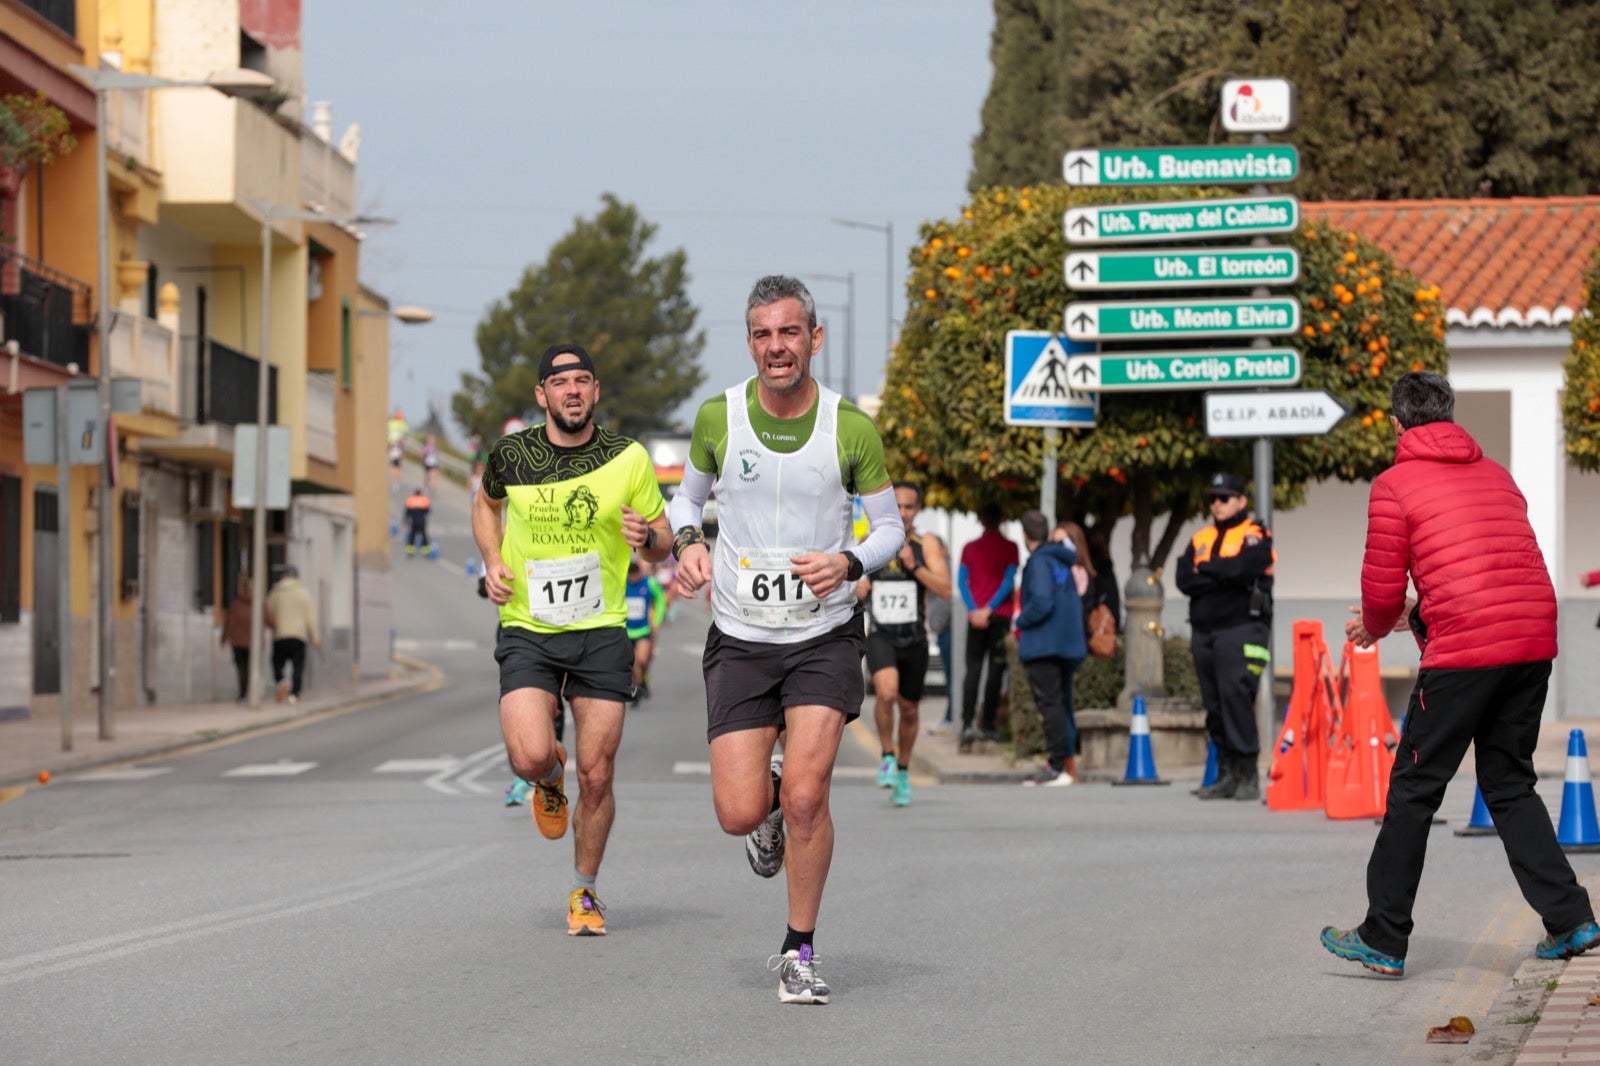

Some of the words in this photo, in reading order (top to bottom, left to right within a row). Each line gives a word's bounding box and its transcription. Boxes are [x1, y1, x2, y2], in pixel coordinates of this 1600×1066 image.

[1103, 155, 1154, 180] Urb.
[1158, 153, 1292, 179] Buenavista
[1101, 213, 1135, 233] Urb.
[1138, 211, 1194, 233] Parque
[1197, 207, 1222, 227] del
[1224, 204, 1288, 226] Cubillas
[1154, 256, 1193, 278] Urb.
[1198, 256, 1217, 276] El
[1220, 254, 1288, 276] torreón
[1129, 309, 1169, 330] Urb.
[1174, 307, 1232, 329] Monte
[1236, 305, 1288, 327] Elvira
[1125, 360, 1165, 381] Urb.
[1169, 357, 1231, 383] Cortijo
[1234, 355, 1290, 377] Pretel
[1268, 402, 1326, 419] ABADÍA
[535, 488, 555, 504] XI
[529, 504, 559, 513] Prueba
[529, 513, 560, 522] Fondo
[530, 524, 554, 533] VILLA
[532, 533, 596, 545] ROMANA
[570, 546, 589, 554] Salar
[542, 574, 589, 605] 177
[752, 573, 805, 602] 617
[880, 595, 908, 609] 572
